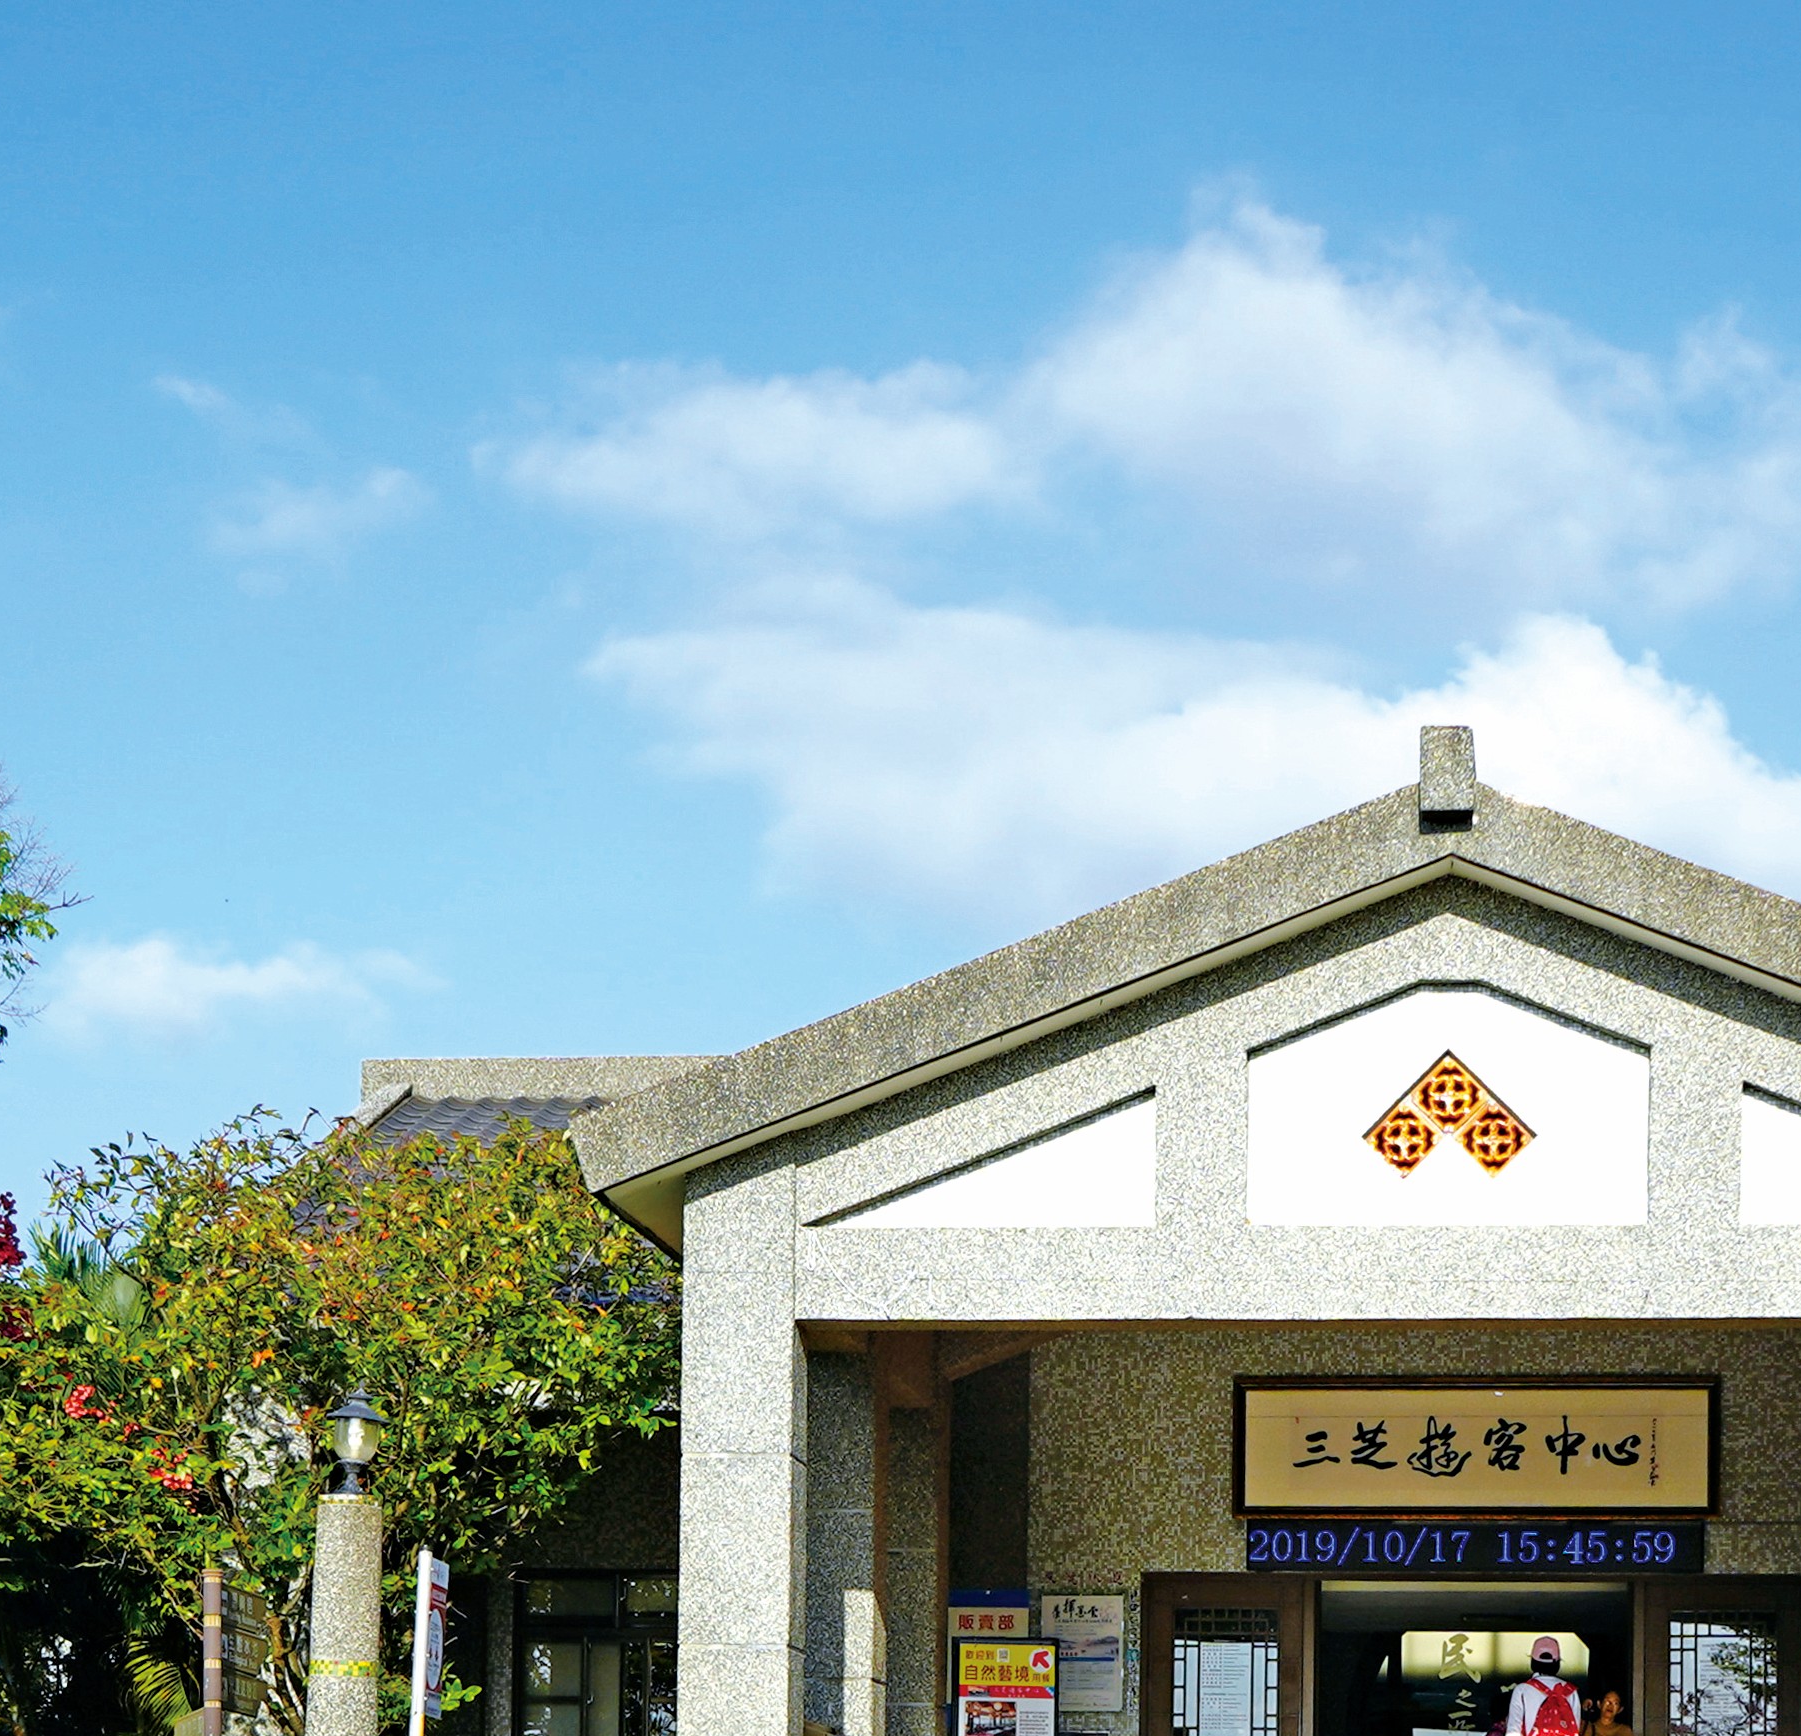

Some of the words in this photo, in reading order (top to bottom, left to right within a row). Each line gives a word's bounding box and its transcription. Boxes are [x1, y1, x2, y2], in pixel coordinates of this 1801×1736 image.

[1293, 1415, 1642, 1478] 三芝遊客中心
[1249, 1526, 1472, 1567] 2019/10/17
[1498, 1531, 1677, 1565] 15:45:59
[958, 1614, 1015, 1631] 販賣部
[965, 1664, 1030, 1682] 自然藝境
